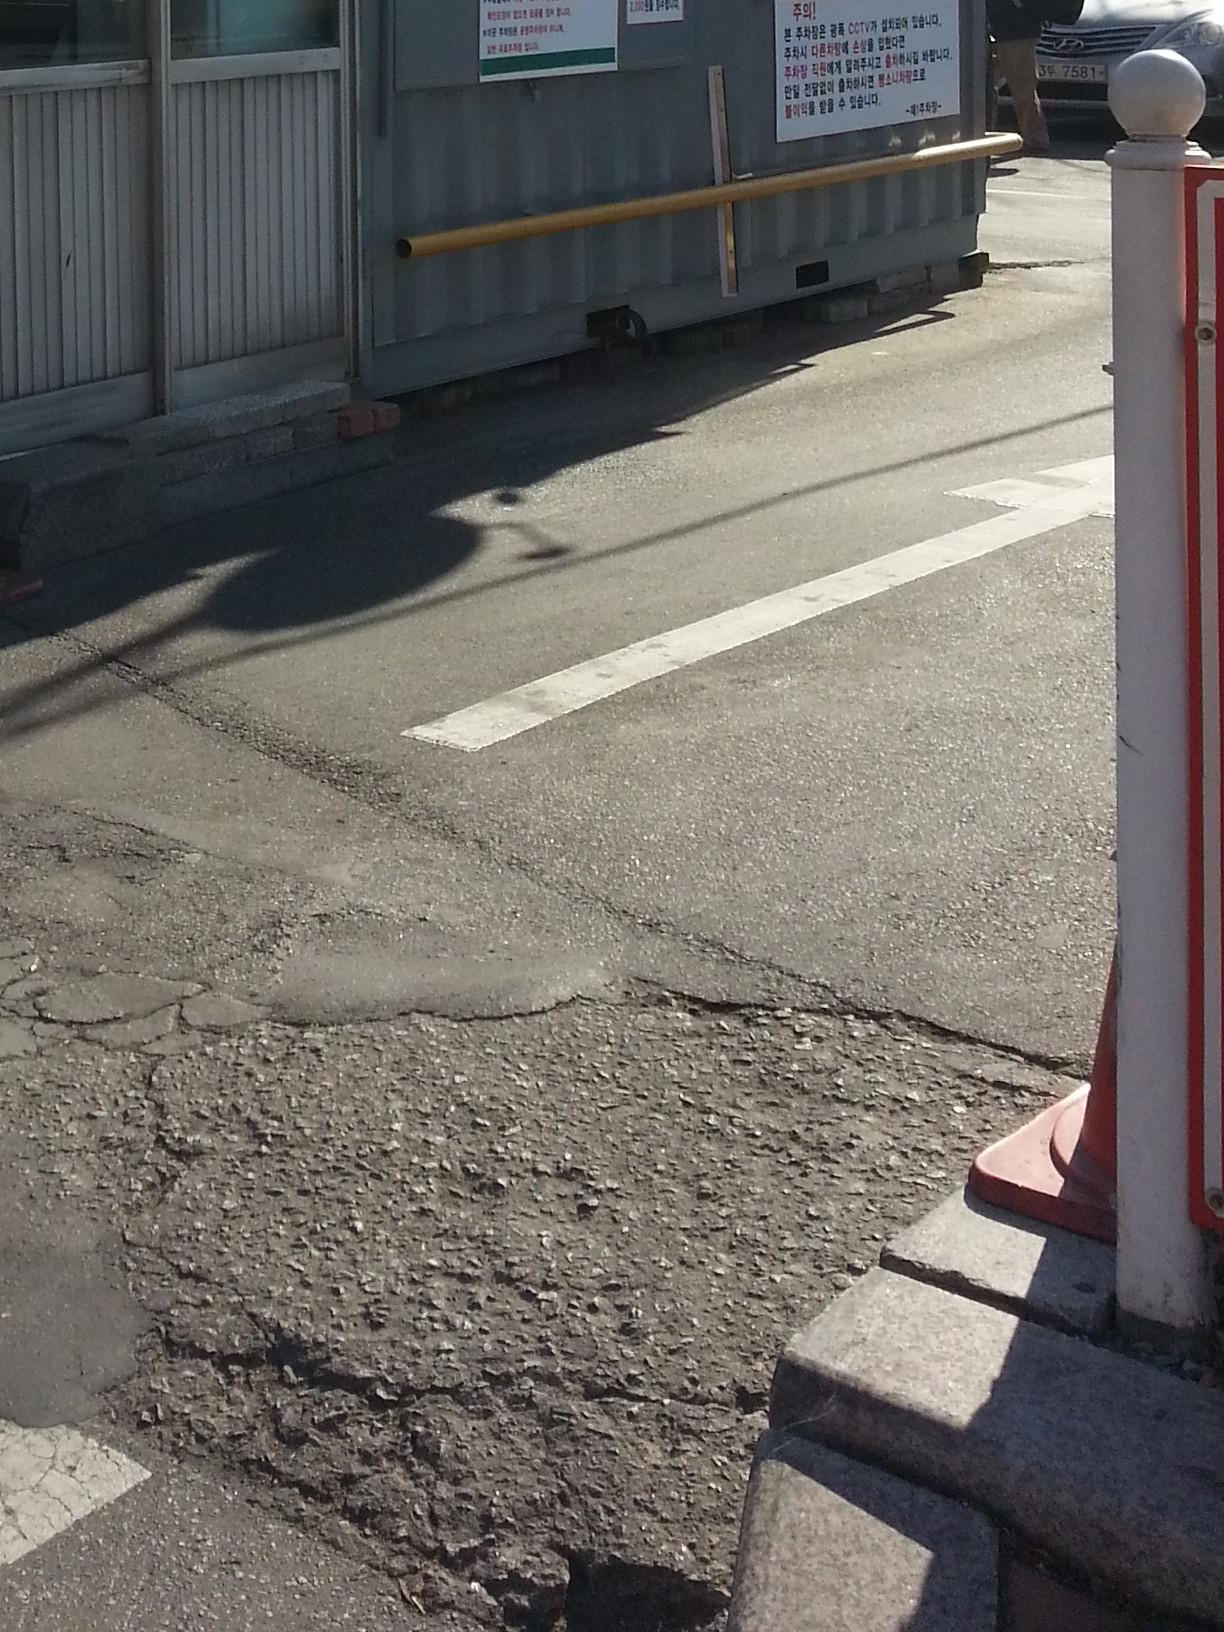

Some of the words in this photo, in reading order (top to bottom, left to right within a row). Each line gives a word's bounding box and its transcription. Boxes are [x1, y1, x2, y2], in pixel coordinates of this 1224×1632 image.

[792, 1, 816, 21] 주의!
[784, 27, 791, 43] 본
[796, 24, 826, 40] 주차장은
[848, 20, 877, 35] CCTV가
[784, 45, 807, 62] 주차시
[784, 64, 807, 81] 주차장
[812, 59, 841, 77] 직원에게
[1063, 64, 1096, 79] 7581
[839, 96, 845, 111] 수
